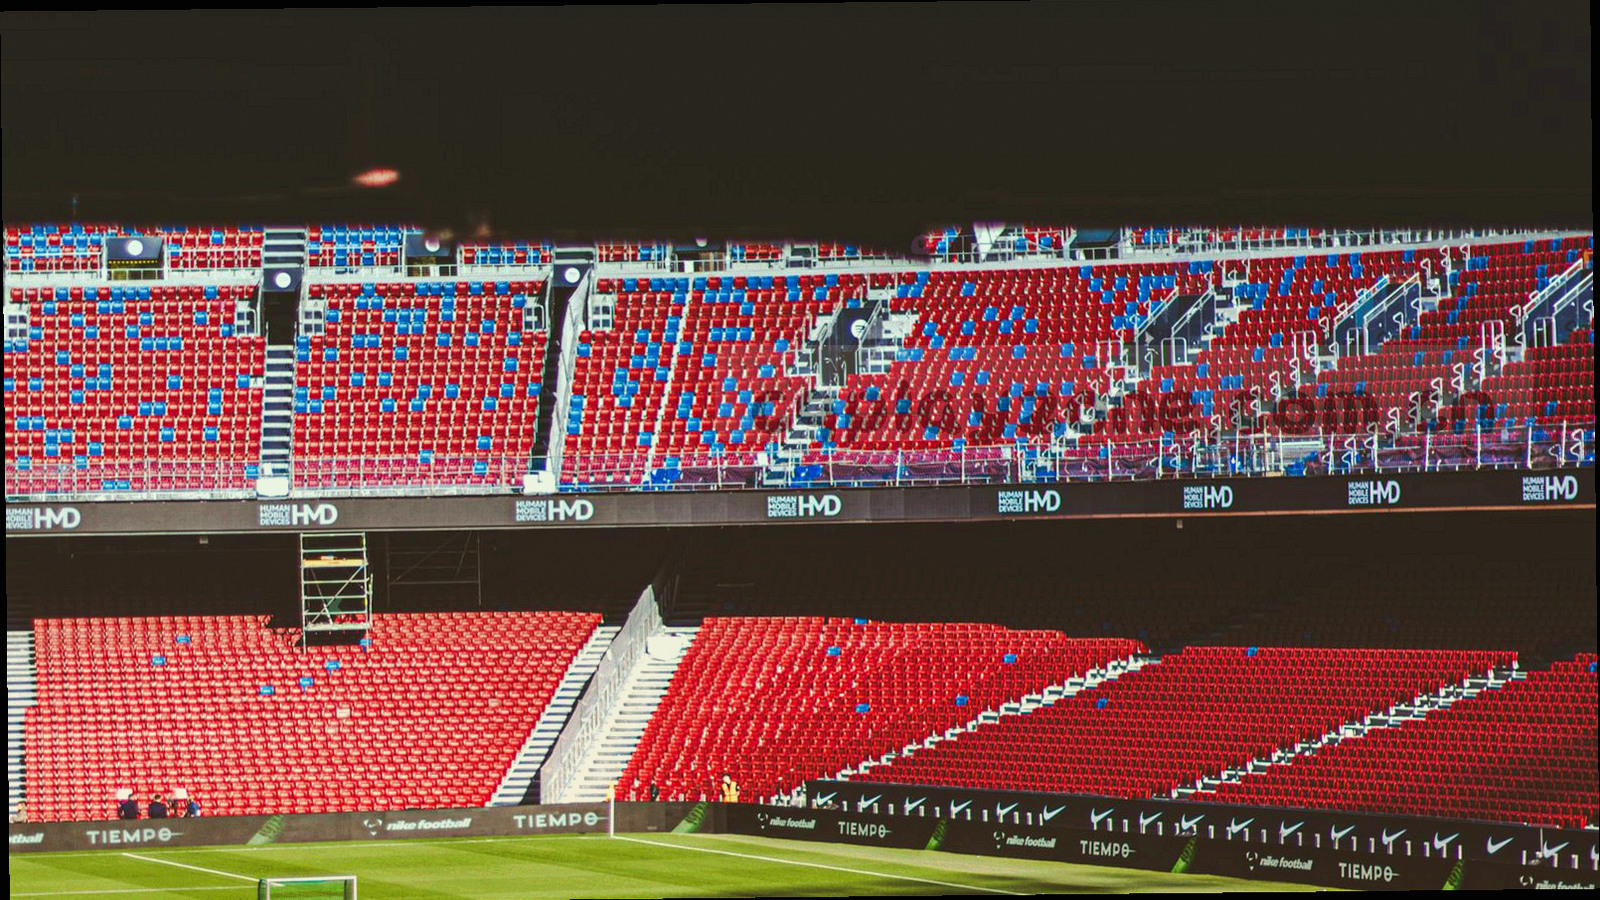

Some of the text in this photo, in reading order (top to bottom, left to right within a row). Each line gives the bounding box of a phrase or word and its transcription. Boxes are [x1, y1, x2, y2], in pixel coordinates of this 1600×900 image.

[1522, 476, 1545, 484] HUMAN
[1545, 475, 1578, 500] HMD
[1024, 490, 1061, 512] HMD
[1204, 485, 1233, 508] HMD
[1370, 481, 1400, 504] HMD
[292, 504, 338, 525] HMD
[548, 500, 594, 521] HMD
[798, 495, 842, 516] HMD
[34, 507, 80, 529] HMD
[386, 817, 472, 831] nike football
[513, 812, 610, 829] TIEMPO
[769, 816, 816, 829] nike football
[838, 821, 892, 838] TIEMPO
[86, 827, 184, 845] TIEMPO
[1006, 835, 1057, 849] nike football
[1080, 840, 1136, 858] TIEMPO
[1259, 855, 1313, 870] nike football
[1339, 862, 1400, 882] TIEMPO
